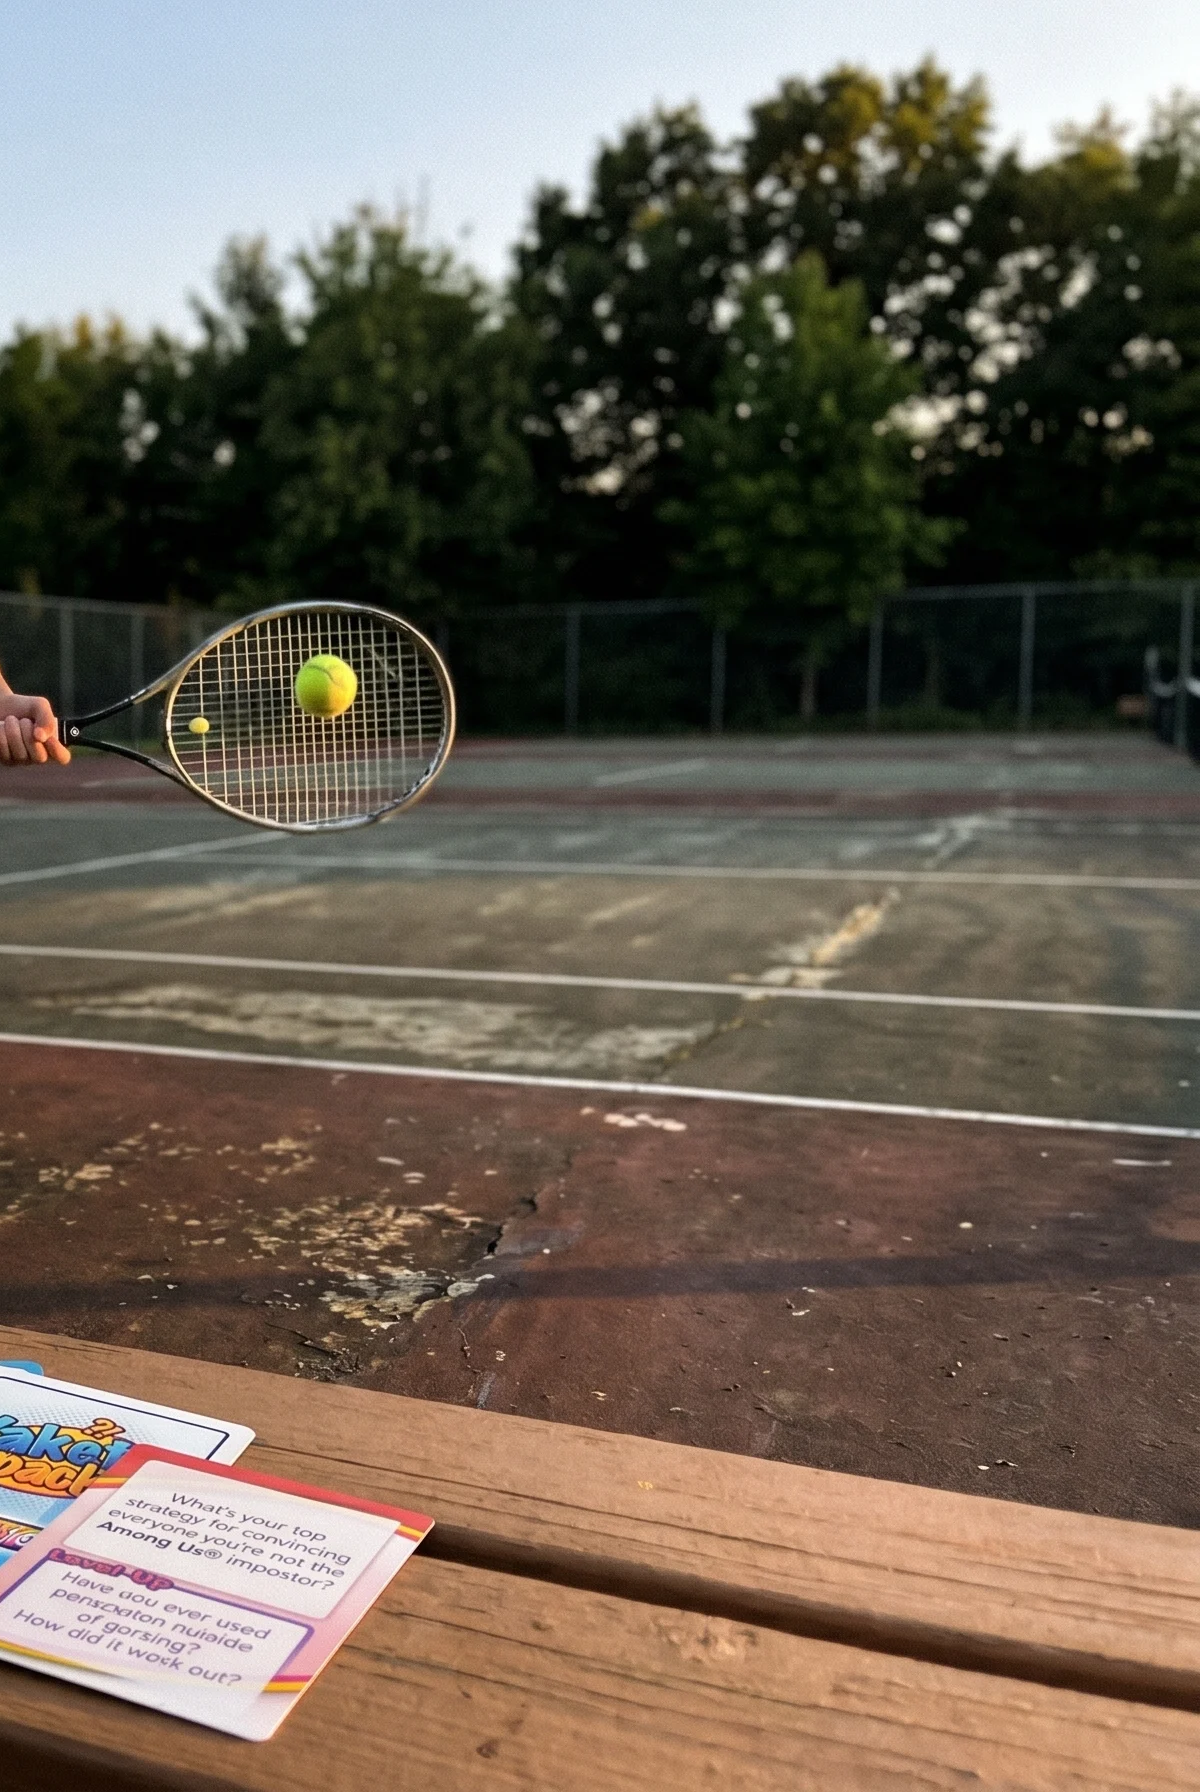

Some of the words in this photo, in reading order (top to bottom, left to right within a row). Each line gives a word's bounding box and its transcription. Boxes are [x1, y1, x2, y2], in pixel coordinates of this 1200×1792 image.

[107, 1508, 199, 1539] everyone
[200, 1533, 265, 1557] you're
[270, 1553, 305, 1568] not
[310, 1560, 346, 1578] the
[125, 1497, 206, 1526] strategy
[209, 1518, 239, 1533] for
[241, 1529, 352, 1567] convincing
[171, 1492, 237, 1519] What's
[239, 1513, 288, 1532] your
[293, 1525, 327, 1543] top
[96, 1520, 173, 1550] Among
[225, 1554, 335, 1591] impostor?
[61, 1571, 115, 1595] Have
[163, 1603, 213, 1622] ever
[216, 1619, 272, 1641] used
[77, 1611, 104, 1624] of
[13, 1609, 65, 1632] How
[67, 1627, 102, 1646] did
[106, 1638, 123, 1652] it
[188, 1664, 243, 1687] out?
